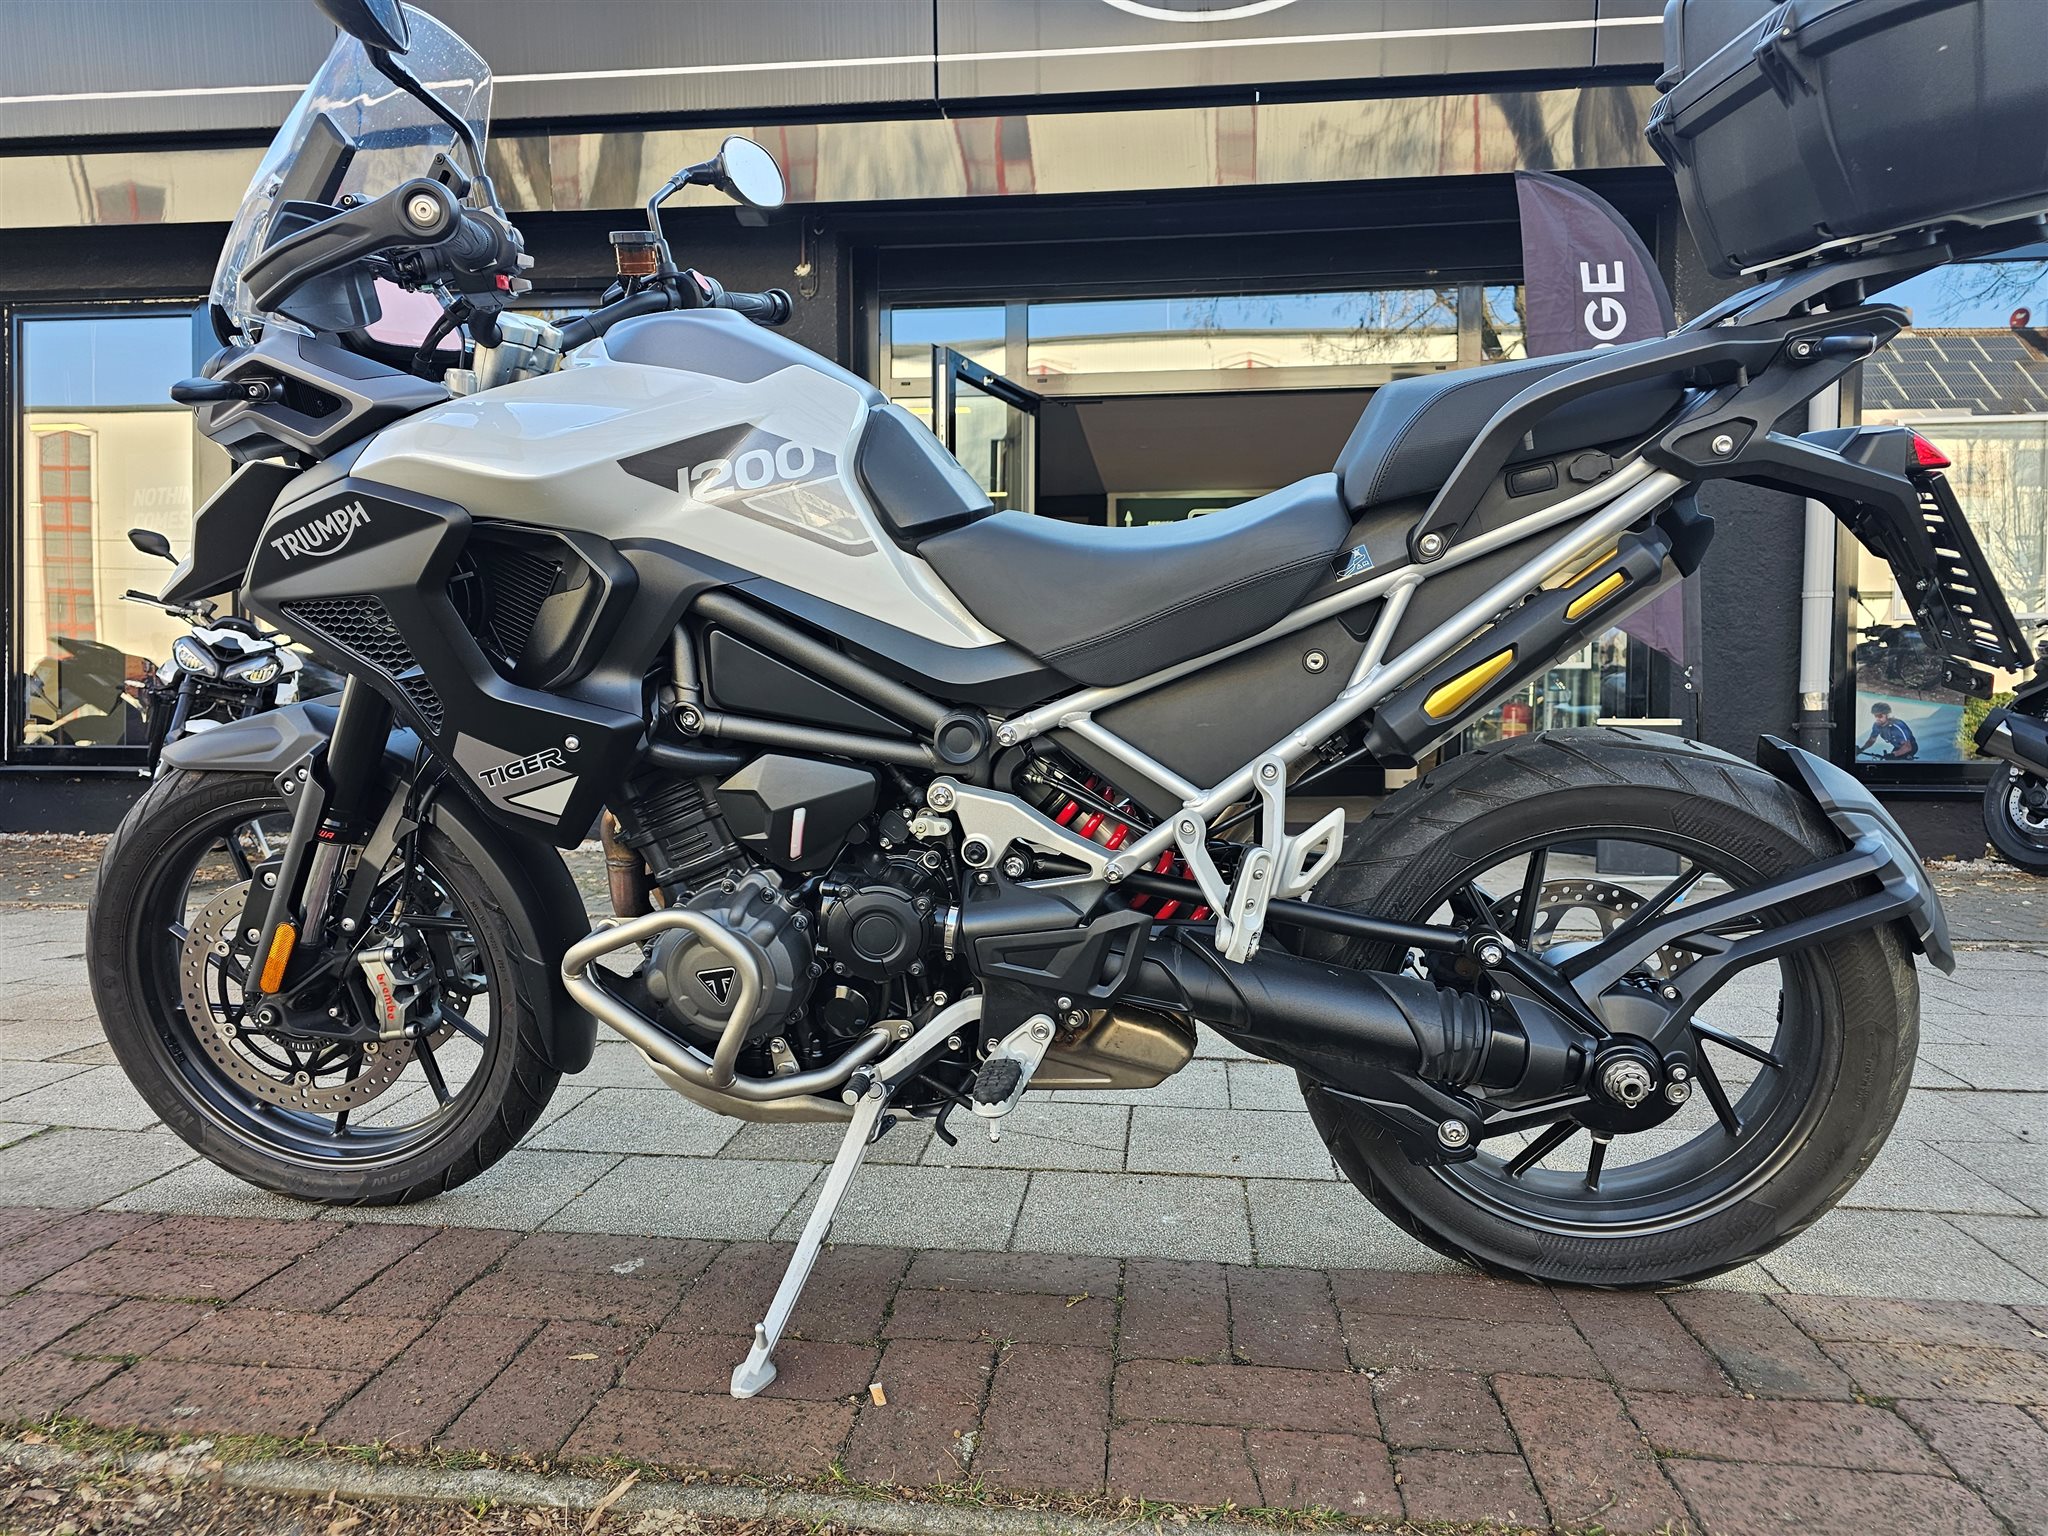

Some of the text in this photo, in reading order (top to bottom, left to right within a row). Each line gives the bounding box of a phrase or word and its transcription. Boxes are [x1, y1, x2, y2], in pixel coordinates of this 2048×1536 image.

[677, 440, 815, 501] 1200
[270, 500, 371, 560] TRIUMPH
[478, 747, 566, 788] TIGER
[376, 973, 396, 1020] brembo
